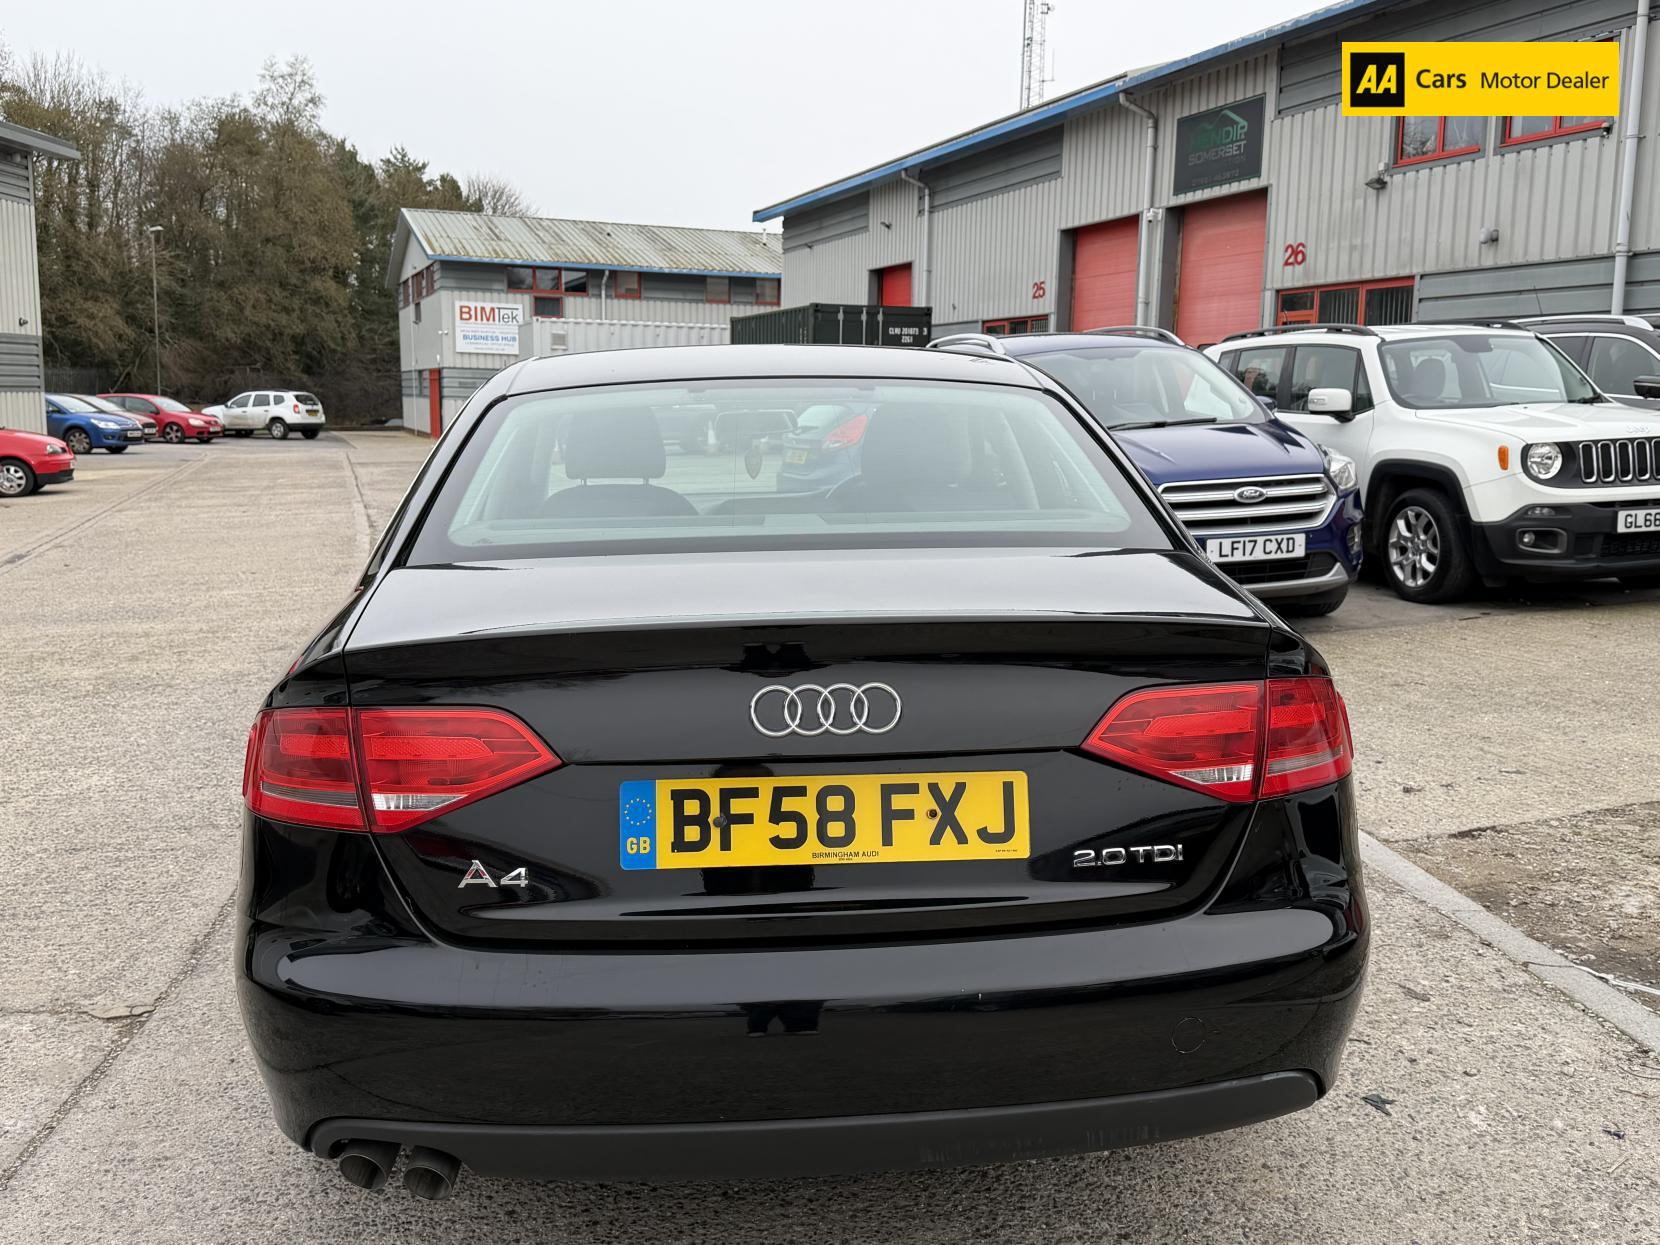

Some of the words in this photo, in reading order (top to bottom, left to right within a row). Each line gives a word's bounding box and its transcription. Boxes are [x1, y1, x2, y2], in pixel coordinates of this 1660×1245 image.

[1187, 141, 1247, 166] SOMERSET
[1283, 242, 1306, 266] 26
[1032, 281, 1046, 299] 25
[459, 305, 520, 324] BIMTek
[462, 334, 500, 343] BUSINESS
[501, 335, 517, 343] HUB
[1218, 540, 1258, 558] LF17
[1263, 537, 1296, 555] CXD
[670, 784, 856, 853] BF58
[880, 780, 1017, 847] FXJ
[626, 836, 651, 854] GB
[811, 851, 860, 859] BIRMINGHAM
[457, 859, 529, 888] A4
